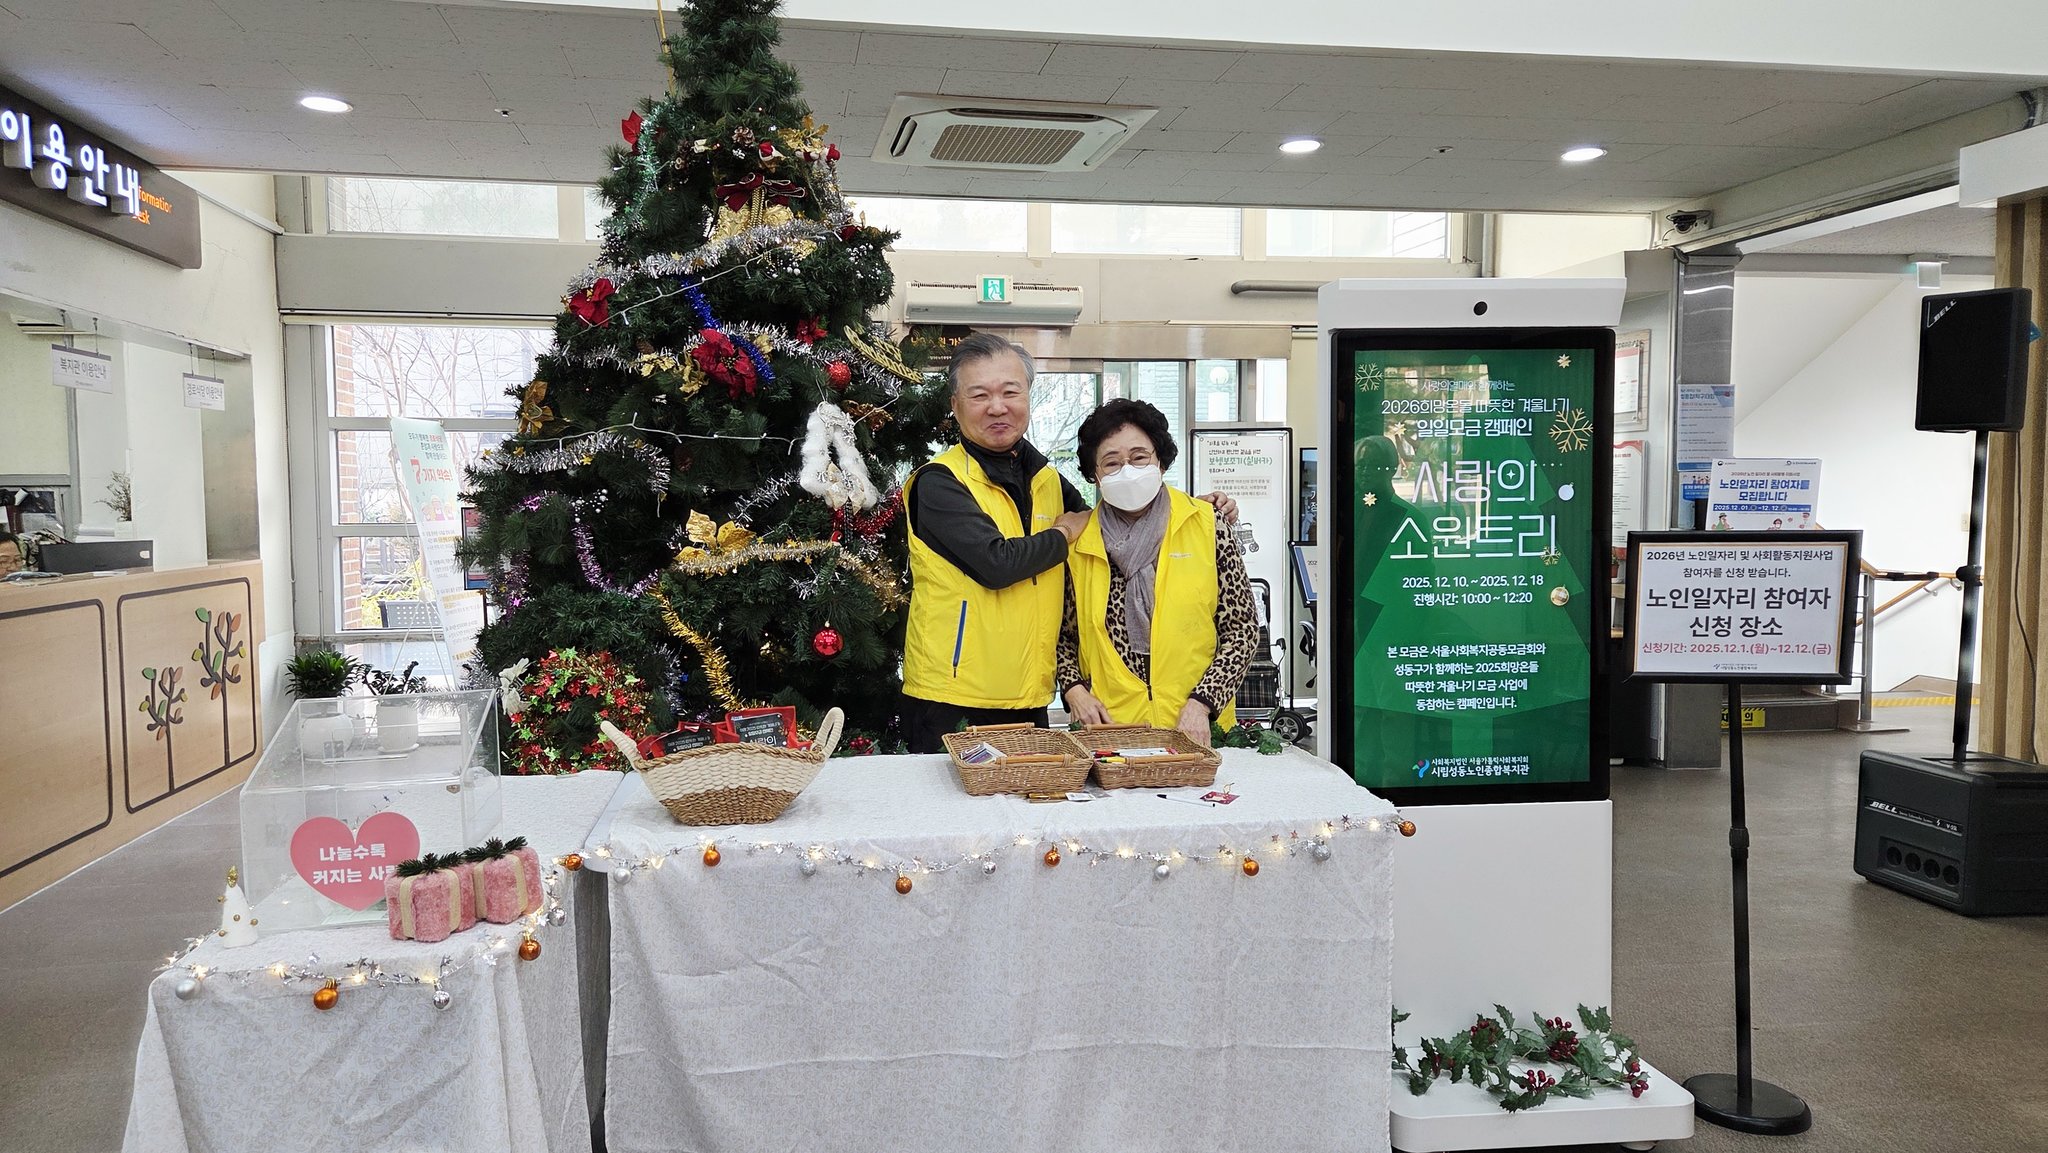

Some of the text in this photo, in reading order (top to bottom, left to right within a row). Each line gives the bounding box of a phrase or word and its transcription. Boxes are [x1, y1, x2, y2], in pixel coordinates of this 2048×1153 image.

[0, 110, 140, 217] 이용안내
[1933, 298, 1957, 322] BELL
[60, 357, 107, 380] 복지관 이용안내
[1381, 398, 1569, 414] 2026희망온돌 따뜻한 겨울나기
[1417, 418, 1532, 438] 일일모금 캠페인
[1412, 459, 1535, 503] 사랑의
[1719, 479, 1768, 489] 노인일자리
[1770, 479, 1810, 490] 참여자를
[1739, 491, 1788, 501] 모집합니다
[1390, 514, 1556, 560] 소원트리
[1646, 550, 1833, 561] 2026년 노인일자리 및 사회활동지원사업
[1683, 568, 1791, 578] 참여자를 신청 받습니다.
[1402, 577, 1432, 588] 2025.
[1435, 577, 1450, 588] 12.
[1453, 577, 1469, 587] 10.
[1480, 576, 1510, 587] 2025.
[1530, 575, 1544, 585] 18
[1413, 593, 1459, 606] 진행시간:
[1461, 593, 1491, 604] 10:00
[1502, 592, 1533, 603] 12:20
[1646, 587, 1832, 610] 노인일자리 참여자
[1689, 615, 1783, 638] 신청 장소
[1387, 643, 1546, 658] 본 모금은 서울사회복지공동모금회와
[1642, 643, 1687, 654] 신청기간:
[1394, 663, 1433, 676] 성동구가
[1434, 663, 1474, 675] 함께하는
[1405, 679, 1528, 693] 따뜻한 겨울나기 모금 사업에
[1416, 697, 1517, 711] 동참하는 캠페인입니다.
[1431, 758, 1467, 766] 사회복지법인
[1431, 764, 1530, 777] 시립성동노인종합복지관
[1870, 801, 1898, 814] BELL
[319, 843, 386, 862] 나눌수록
[313, 868, 362, 885] 커지는
